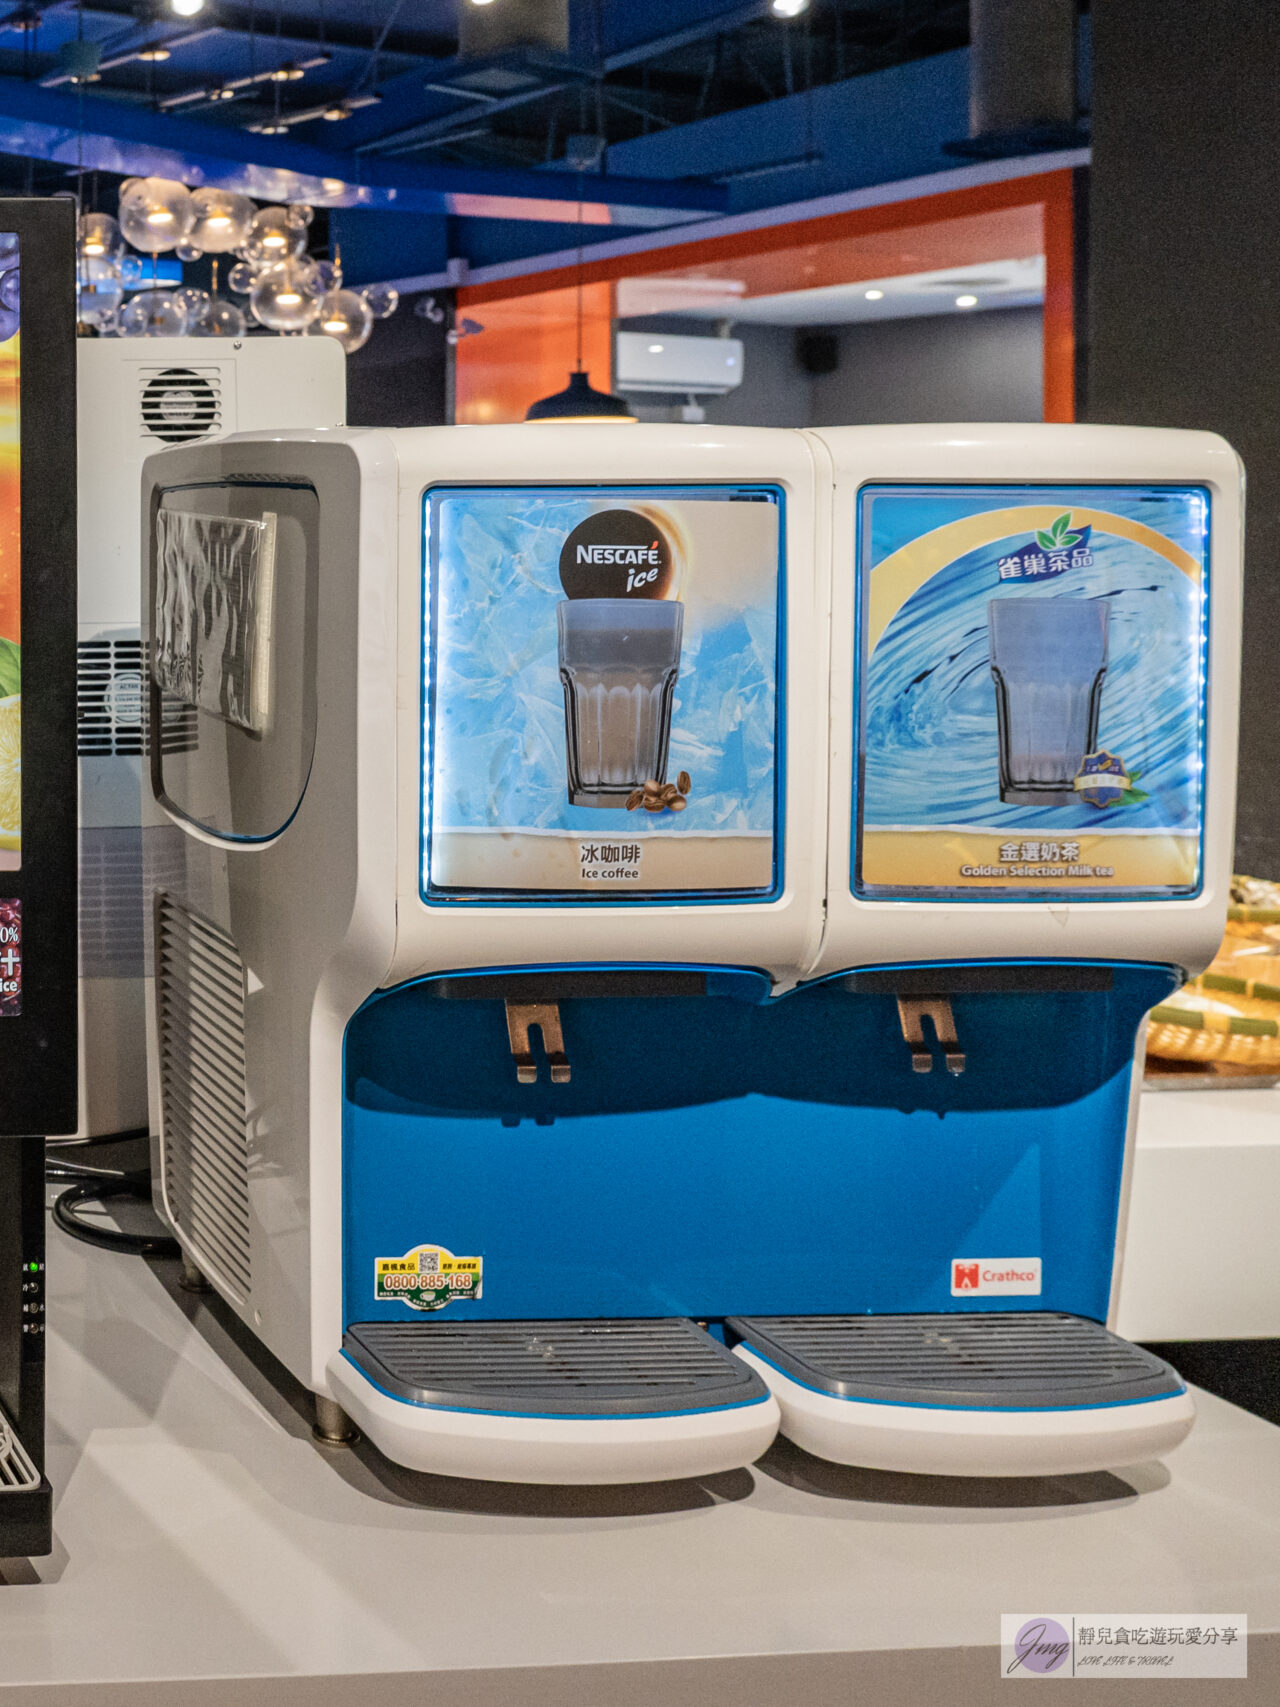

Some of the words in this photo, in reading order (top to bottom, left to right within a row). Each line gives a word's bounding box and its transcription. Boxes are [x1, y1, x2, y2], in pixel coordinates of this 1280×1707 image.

[998, 547, 1095, 579] 雀巢茶品
[626, 567, 659, 592] ice
[580, 844, 641, 864] 冰咖啡
[999, 841, 1080, 862] 金選奶茶
[581, 868, 598, 878] Ice
[601, 867, 639, 879] coffee
[961, 865, 1007, 877] Golden
[1010, 865, 1065, 877] Selection
[1068, 865, 1093, 877] Milk
[1095, 866, 1115, 877] tea
[982, 1268, 1035, 1282] Crathco
